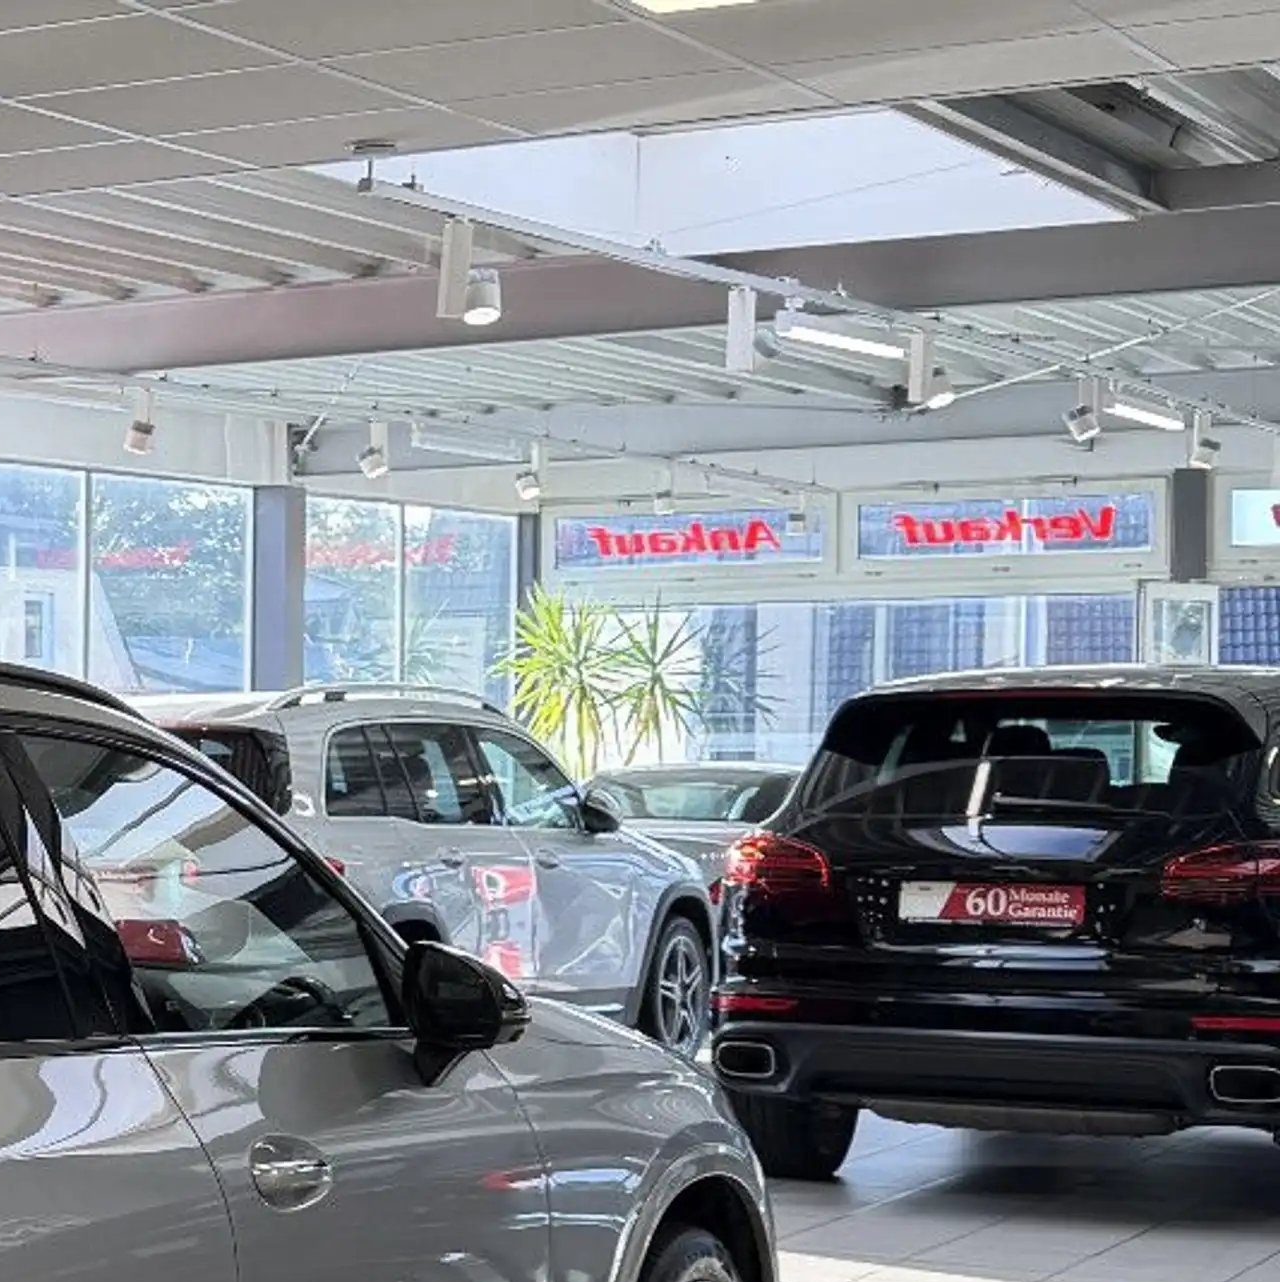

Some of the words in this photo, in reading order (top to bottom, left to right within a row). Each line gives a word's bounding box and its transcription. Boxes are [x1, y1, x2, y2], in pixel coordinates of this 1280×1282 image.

[965, 887, 1008, 916] 60
[1009, 888, 1070, 904] Monate
[1008, 902, 1078, 919] Garantie
